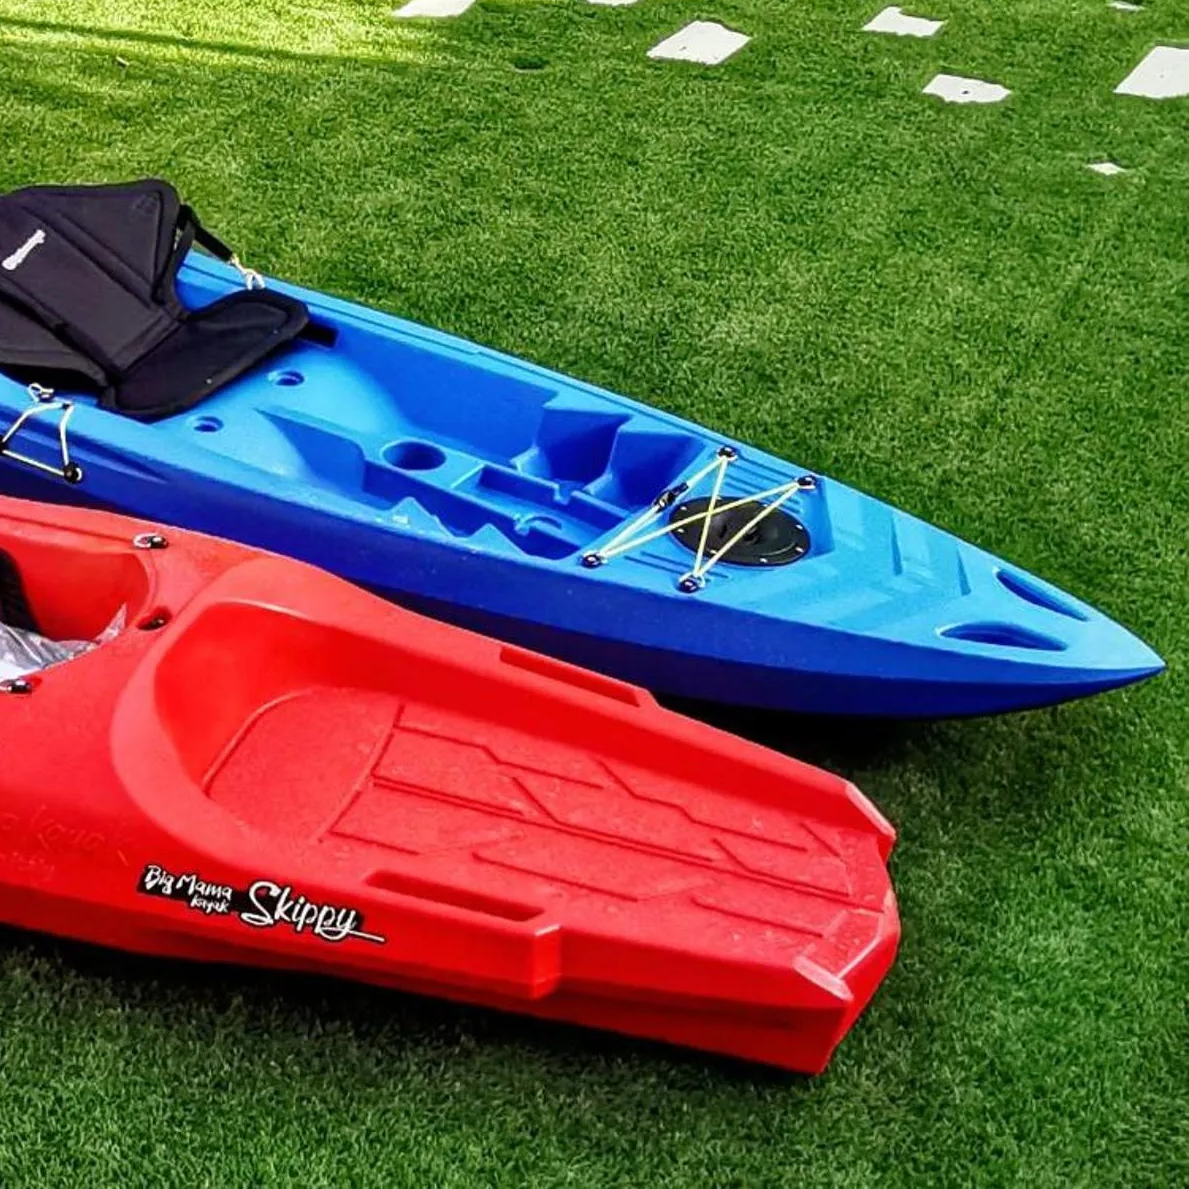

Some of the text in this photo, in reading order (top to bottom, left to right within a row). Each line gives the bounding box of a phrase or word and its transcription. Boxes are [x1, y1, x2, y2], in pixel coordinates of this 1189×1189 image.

[144, 865, 233, 902] Big Mama
[241, 881, 386, 943] Skippy
